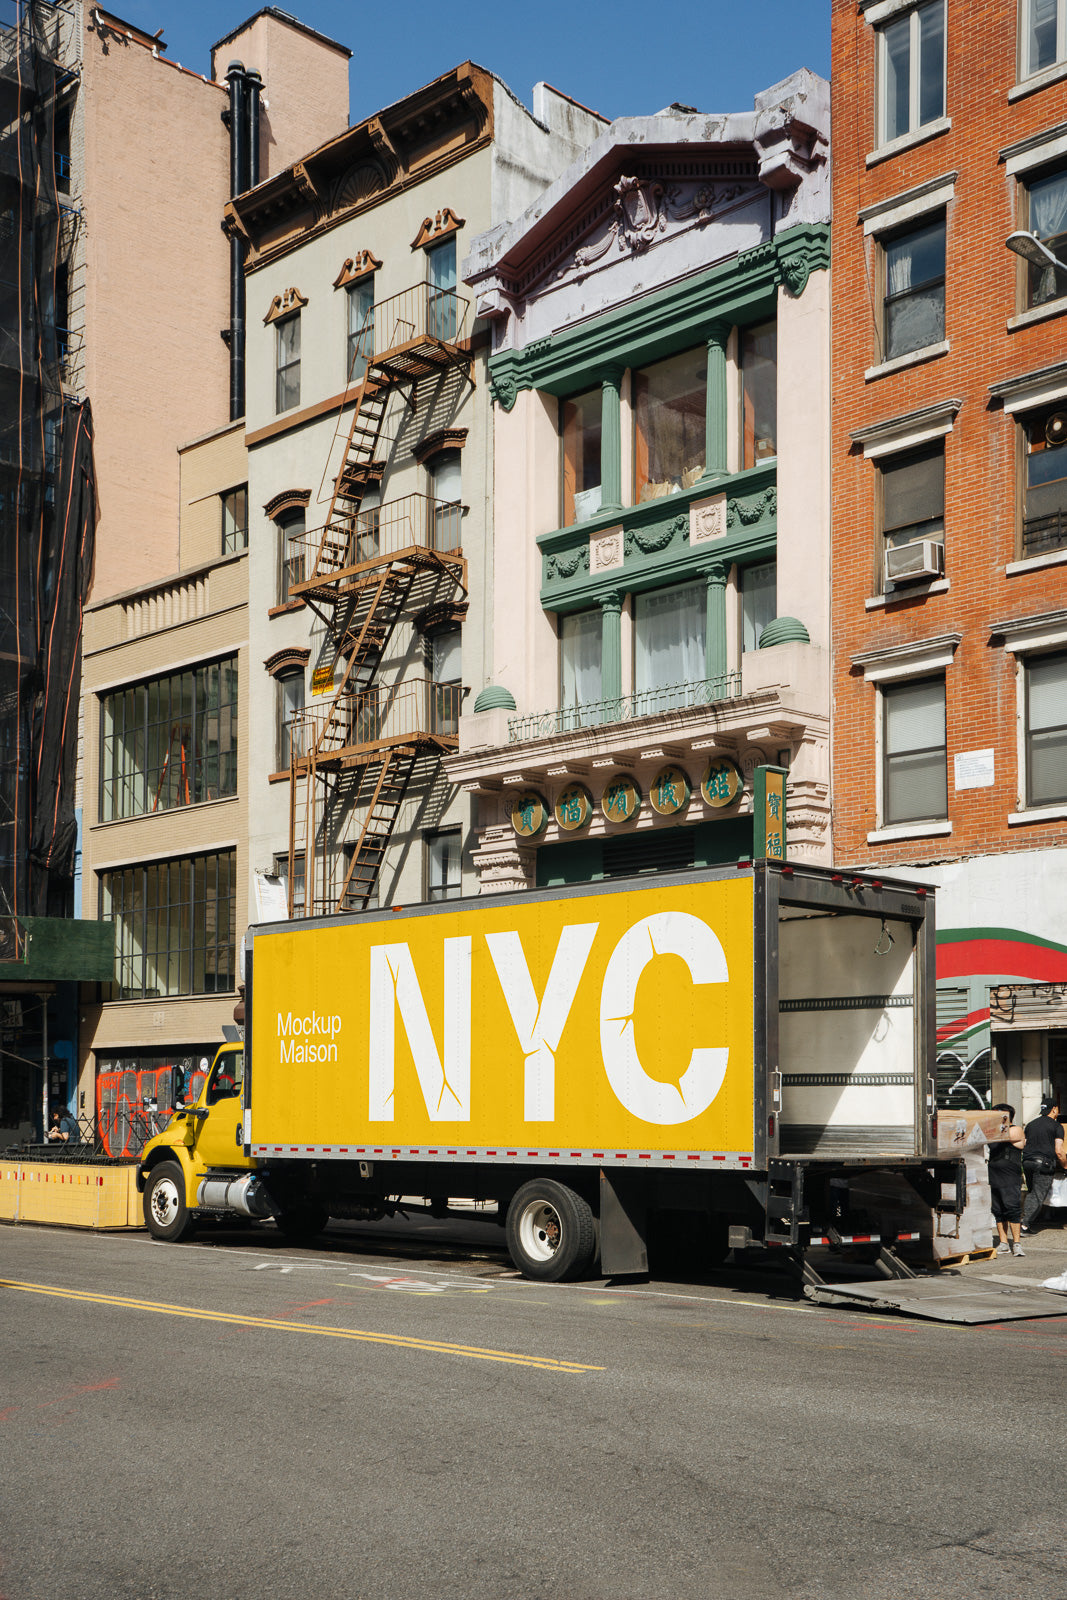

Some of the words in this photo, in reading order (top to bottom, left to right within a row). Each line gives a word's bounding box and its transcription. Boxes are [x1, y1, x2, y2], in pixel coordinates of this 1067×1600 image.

[767, 792, 782, 858] 寶福
[277, 1010, 342, 1040] Mockup
[368, 911, 729, 1125] NYC
[280, 1038, 338, 1064] Maison
